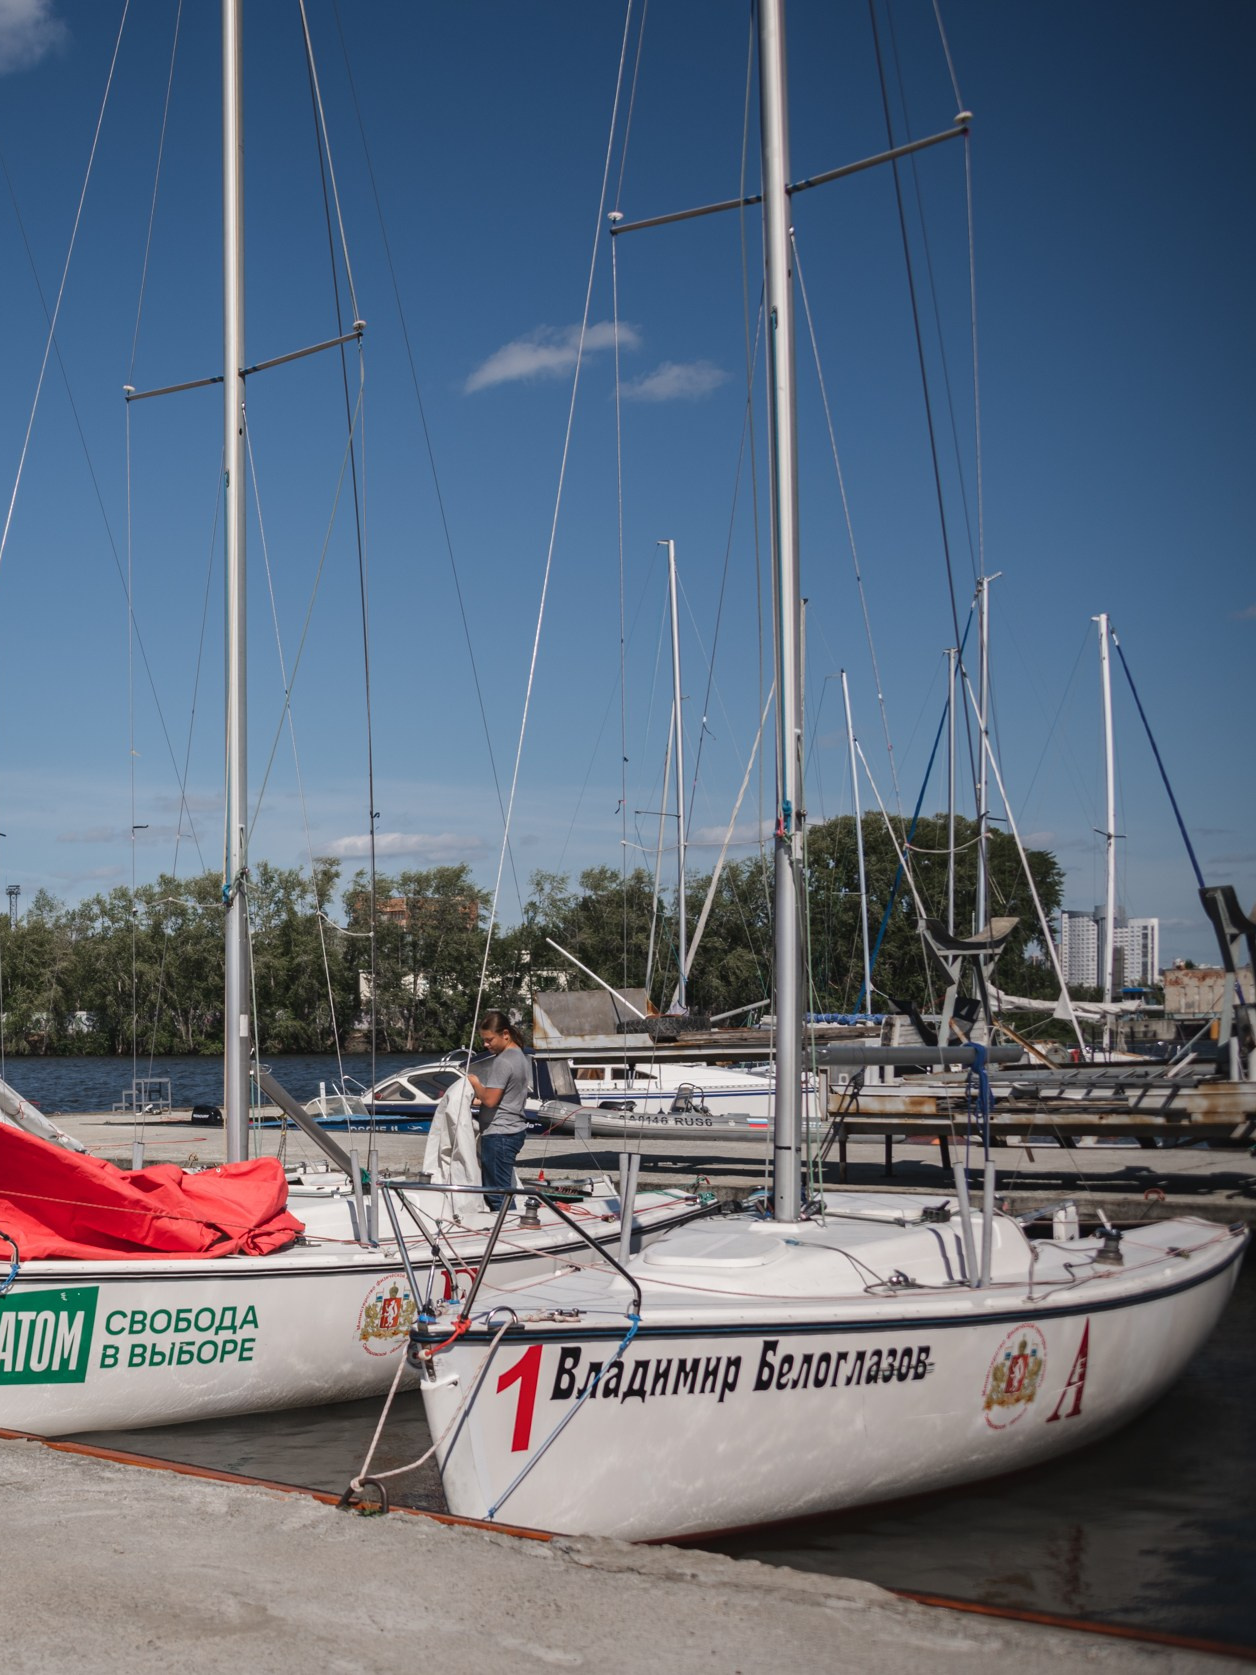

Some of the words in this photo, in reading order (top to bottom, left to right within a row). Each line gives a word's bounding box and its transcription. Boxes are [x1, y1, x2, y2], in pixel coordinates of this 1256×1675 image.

[104, 1304, 259, 1336] СВОБОДА
[99, 1344, 120, 1369] В
[128, 1338, 257, 1368] ВЫБОРЕ
[551, 1346, 742, 1404] Владимир
[753, 1338, 931, 1392] Белоглазов
[496, 1343, 544, 1453] 1
